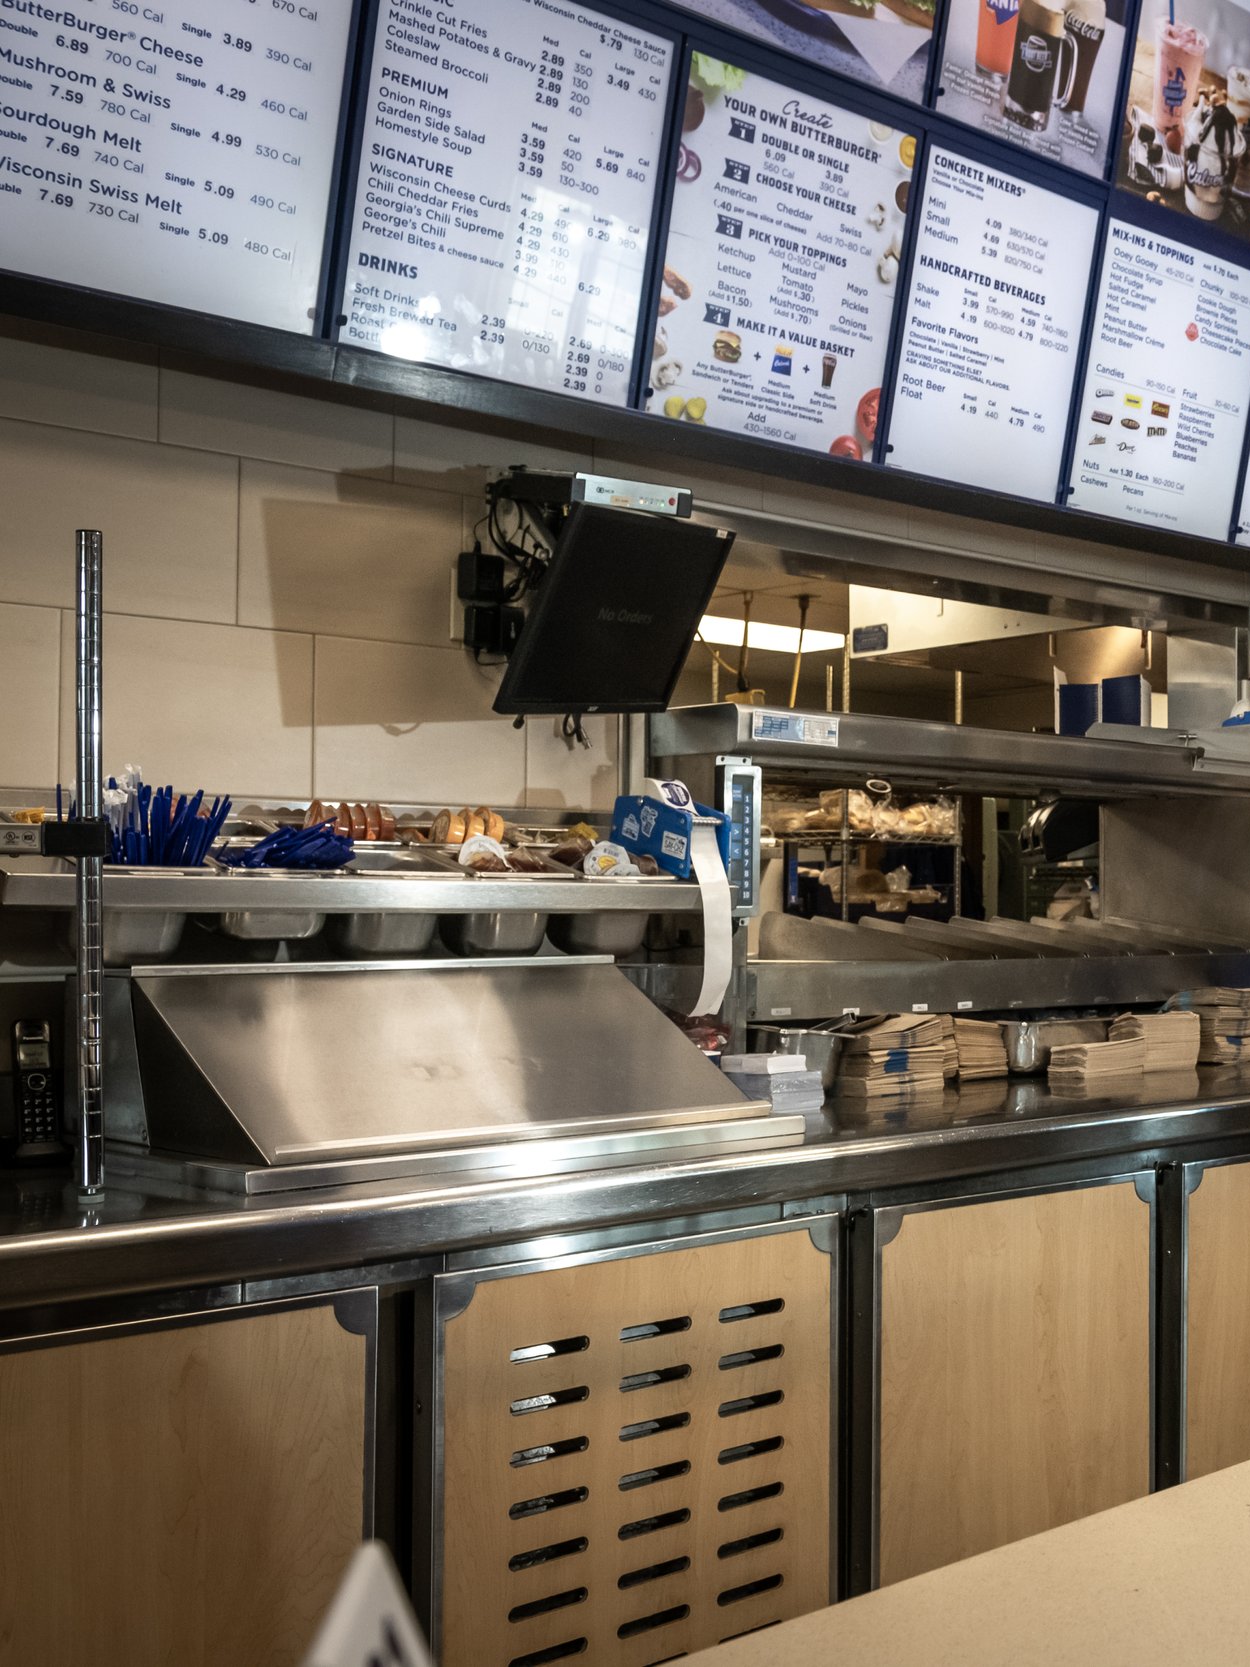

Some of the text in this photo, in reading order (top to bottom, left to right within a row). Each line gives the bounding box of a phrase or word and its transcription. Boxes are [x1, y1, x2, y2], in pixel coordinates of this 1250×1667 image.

[140, 37, 203, 67] Cheese
[387, 25, 440, 52] Coleslaw
[389, 10, 536, 72] Mashed Potatoes & Gravy
[0, 47, 172, 109] Mushroom & Swiss
[385, 39, 489, 84] Steamed Broccoli
[382, 67, 449, 99] PREMIUM
[379, 87, 452, 120] Onion Rings
[724, 96, 756, 117] YOUR
[760, 110, 787, 129] OWN
[782, 100, 834, 129] Create
[375, 116, 472, 156] Homestyle Soup
[377, 101, 485, 144] Garden Side Salad
[103, 130, 142, 153] Melt
[762, 133, 849, 173] DOUBLE OR SINGLE
[372, 143, 454, 177] SIGNATURE
[935, 154, 984, 183] CONCRETE
[89, 179, 139, 203] Swiss
[145, 193, 183, 215] Melt
[368, 177, 479, 218] Chili Cheddar Fries
[370, 162, 511, 213] Wisconsin Cheese Curds
[756, 173, 857, 216] CHOOSE YOUR CHEESE
[929, 196, 946, 210] Mini
[39, 189, 291, 262] 7.69 730 Cal Single 5.09 480 Cal
[924, 225, 958, 245] Medium
[926, 211, 950, 226] Small
[748, 229, 847, 268] PICK YOUR TOPPINGS
[1112, 227, 1194, 266] MIX-INS & TOPPINGS
[358, 252, 418, 279] DRINKS
[920, 255, 1045, 306] HANDCRAFTED BEVERAGES
[737, 317, 855, 359] MAKE IT A VALUE BASKET
[911, 317, 979, 344] Favorite Flavors
[903, 374, 945, 393] Root Beer
[1096, 364, 1125, 379] Candies
[901, 387, 922, 401] Float
[1182, 389, 1197, 400] Fruit
[1082, 460, 1100, 470] Nuts
[598, 607, 653, 625] No Orders
